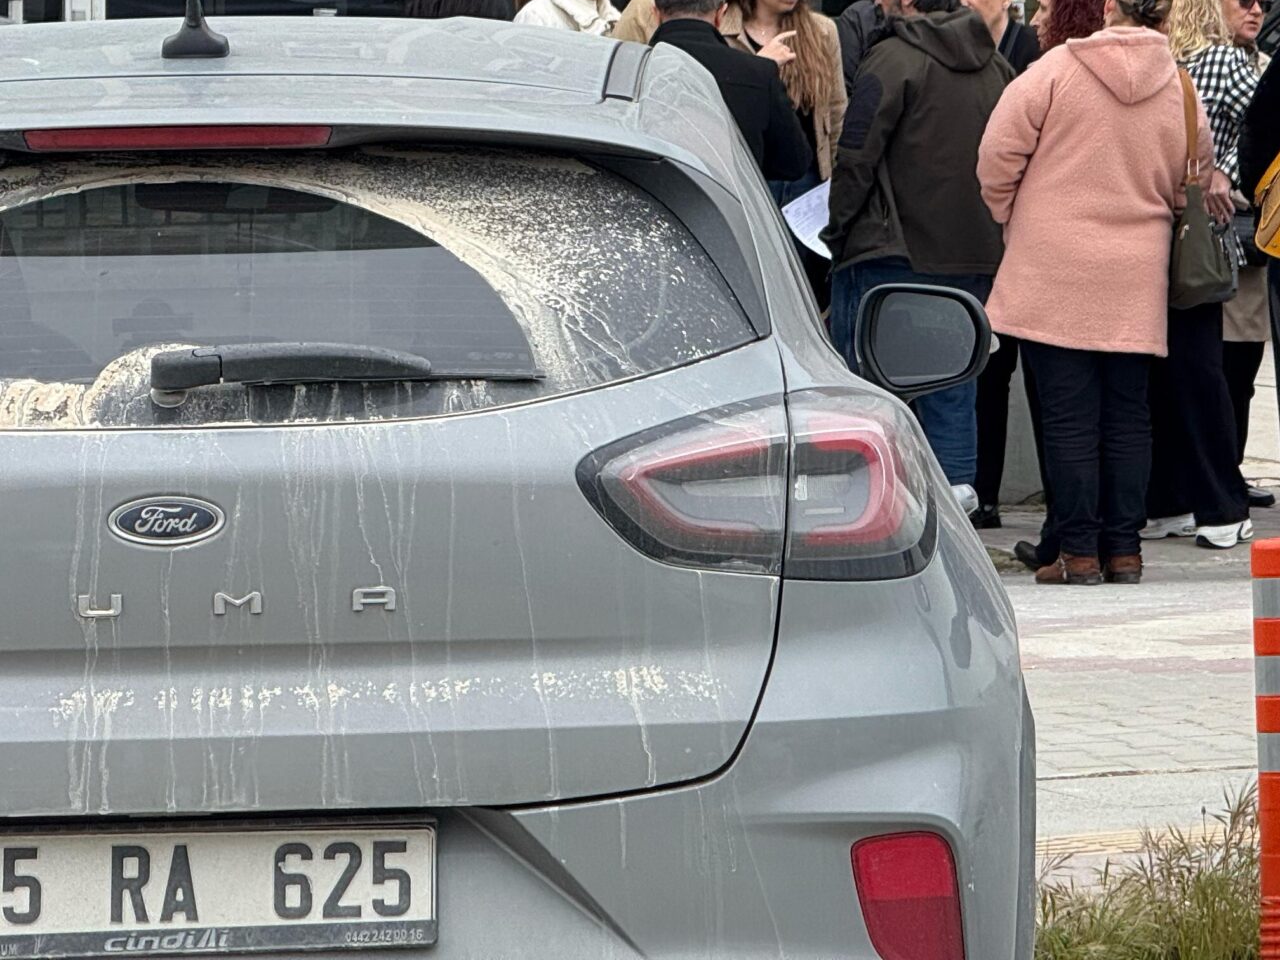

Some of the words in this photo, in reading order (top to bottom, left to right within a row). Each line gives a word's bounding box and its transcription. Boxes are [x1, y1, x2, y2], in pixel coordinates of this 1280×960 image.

[135, 506, 197, 534] Ford
[110, 844, 200, 923] RA
[274, 841, 412, 920] 625
